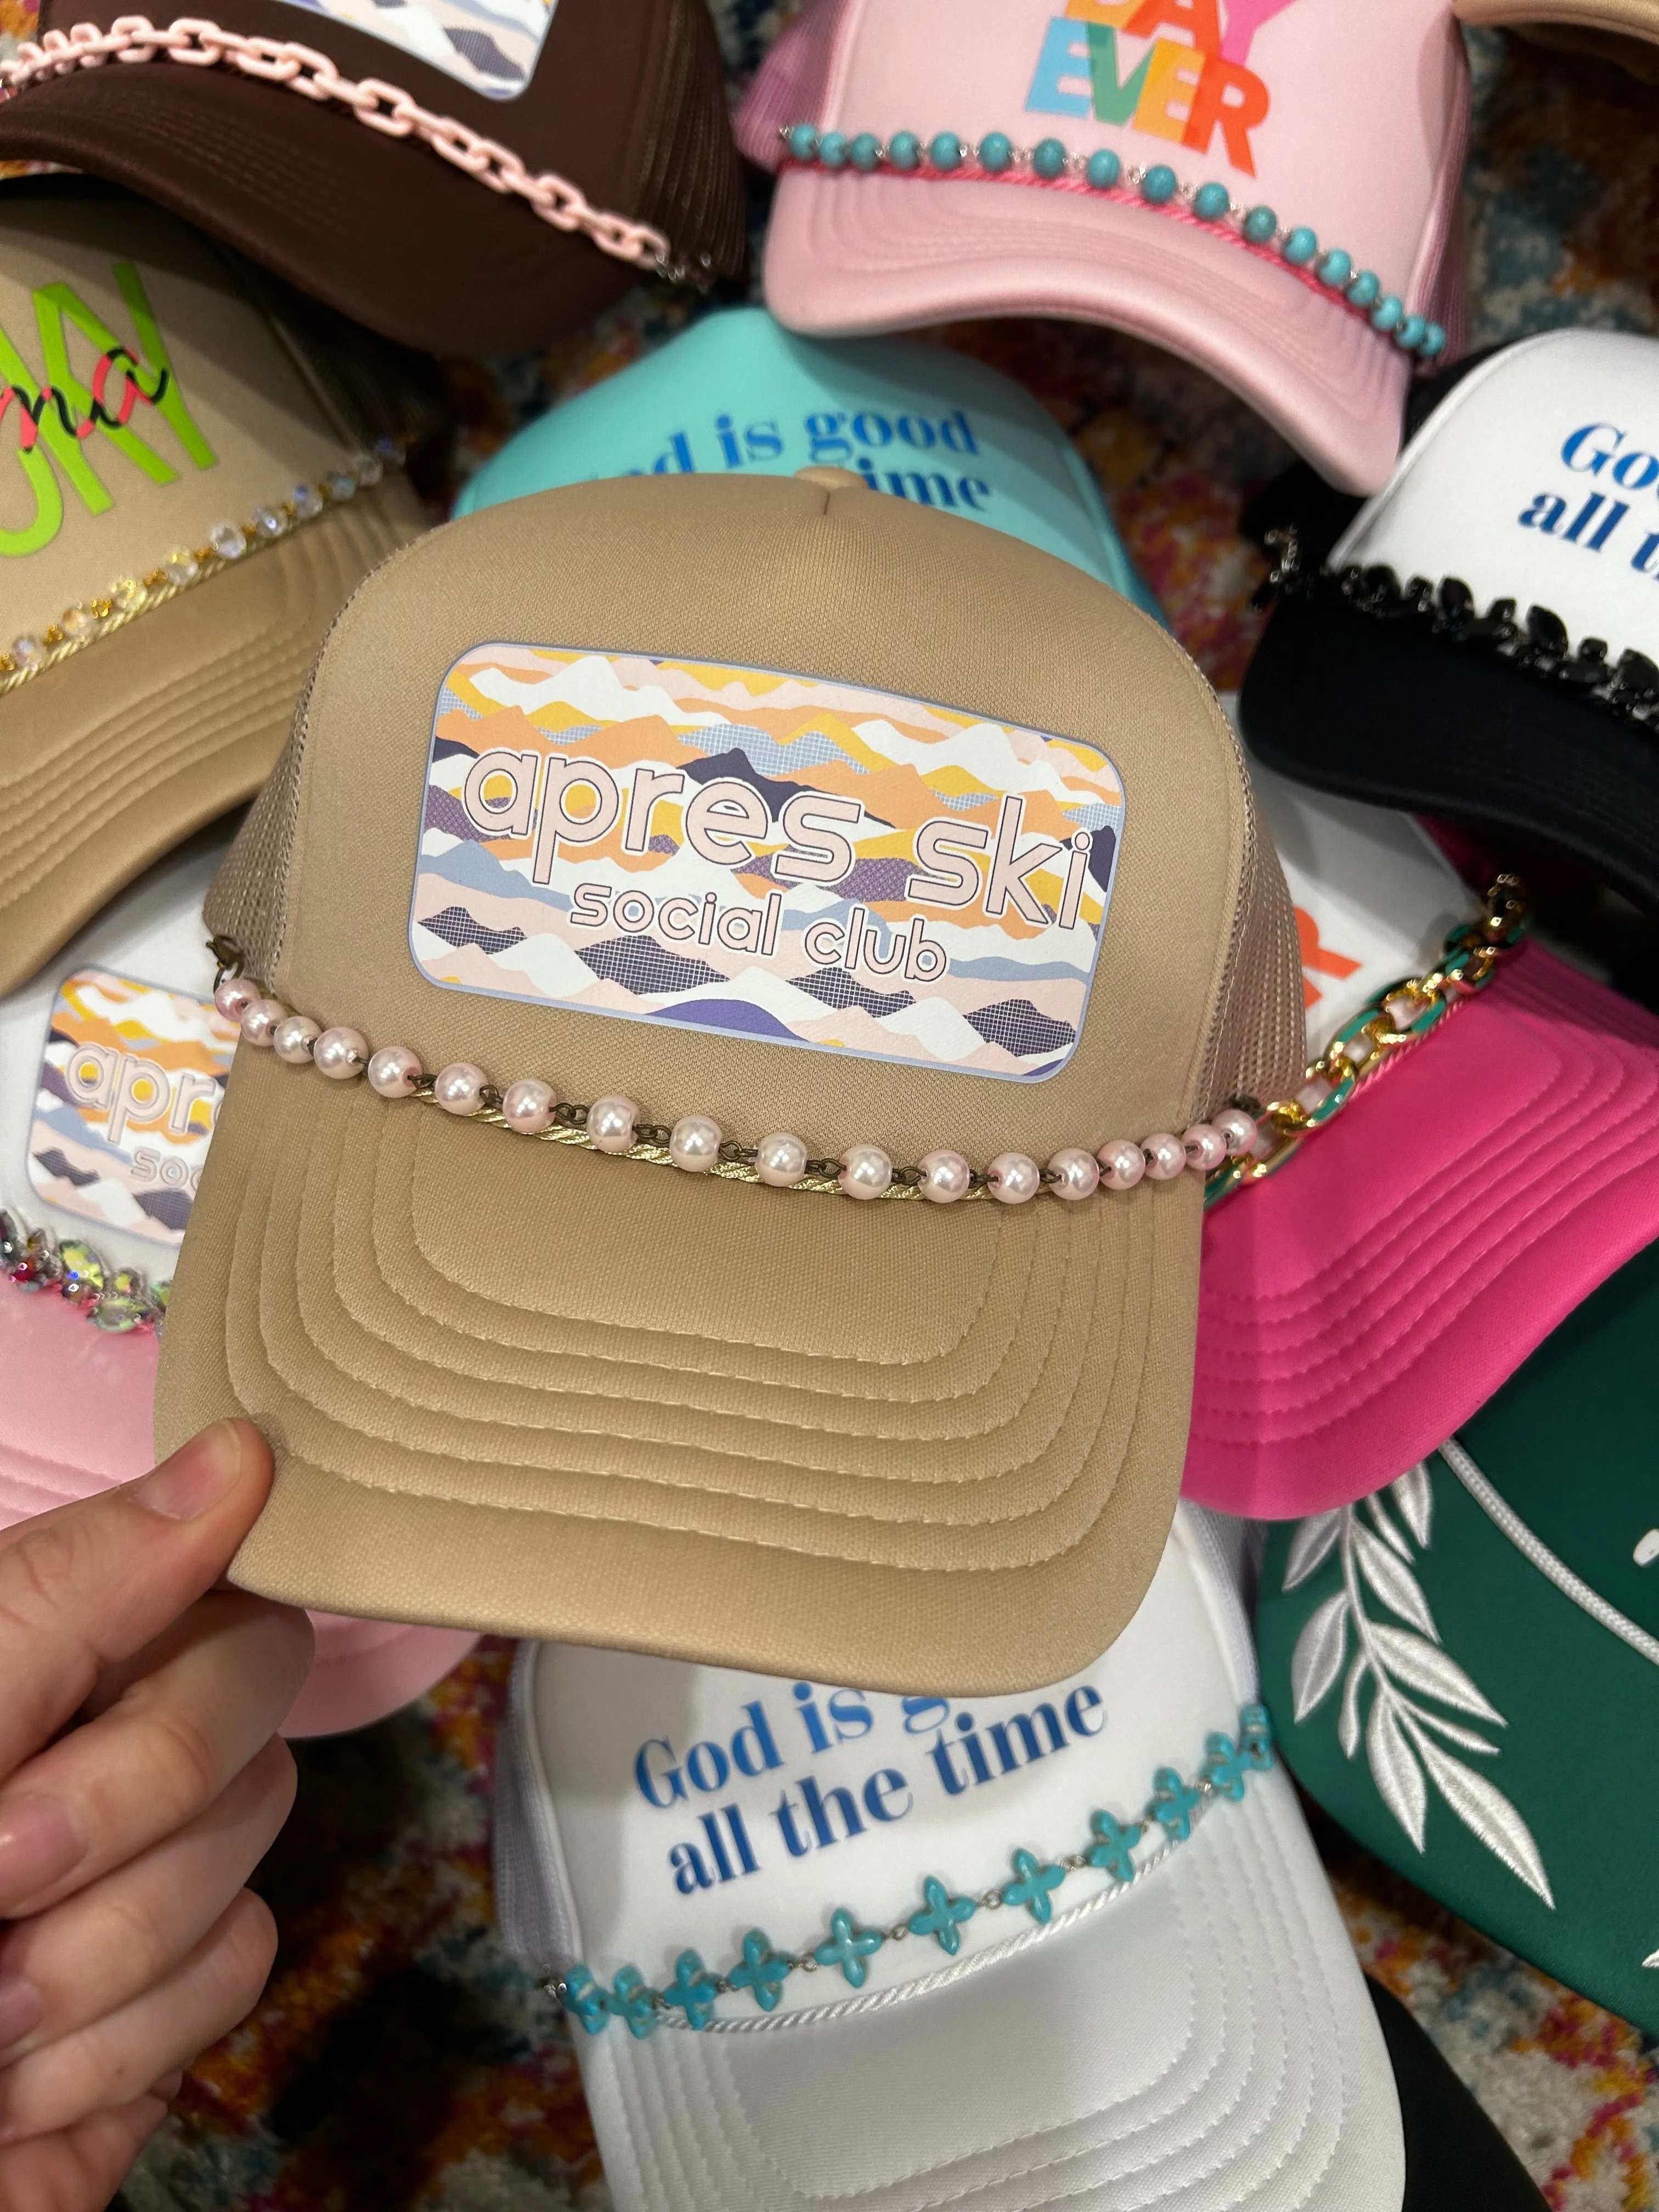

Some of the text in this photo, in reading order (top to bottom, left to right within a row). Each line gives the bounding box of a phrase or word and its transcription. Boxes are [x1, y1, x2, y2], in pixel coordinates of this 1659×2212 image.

[1024, 16, 1271, 178] EVER
[714, 413, 785, 470] is
[803, 408, 980, 466] good
[855, 456, 991, 511] ime
[1560, 421, 1659, 499] Go
[1517, 492, 1630, 553] all
[463, 750, 1092, 930] apres ski
[569, 883, 948, 981] social club
[66, 1044, 223, 1143] apr
[633, 1700, 786, 1809] God
[791, 1681, 875, 1754] is
[668, 1803, 763, 1895] all
[768, 1768, 914, 1858] the
[924, 1684, 1109, 1797] time
